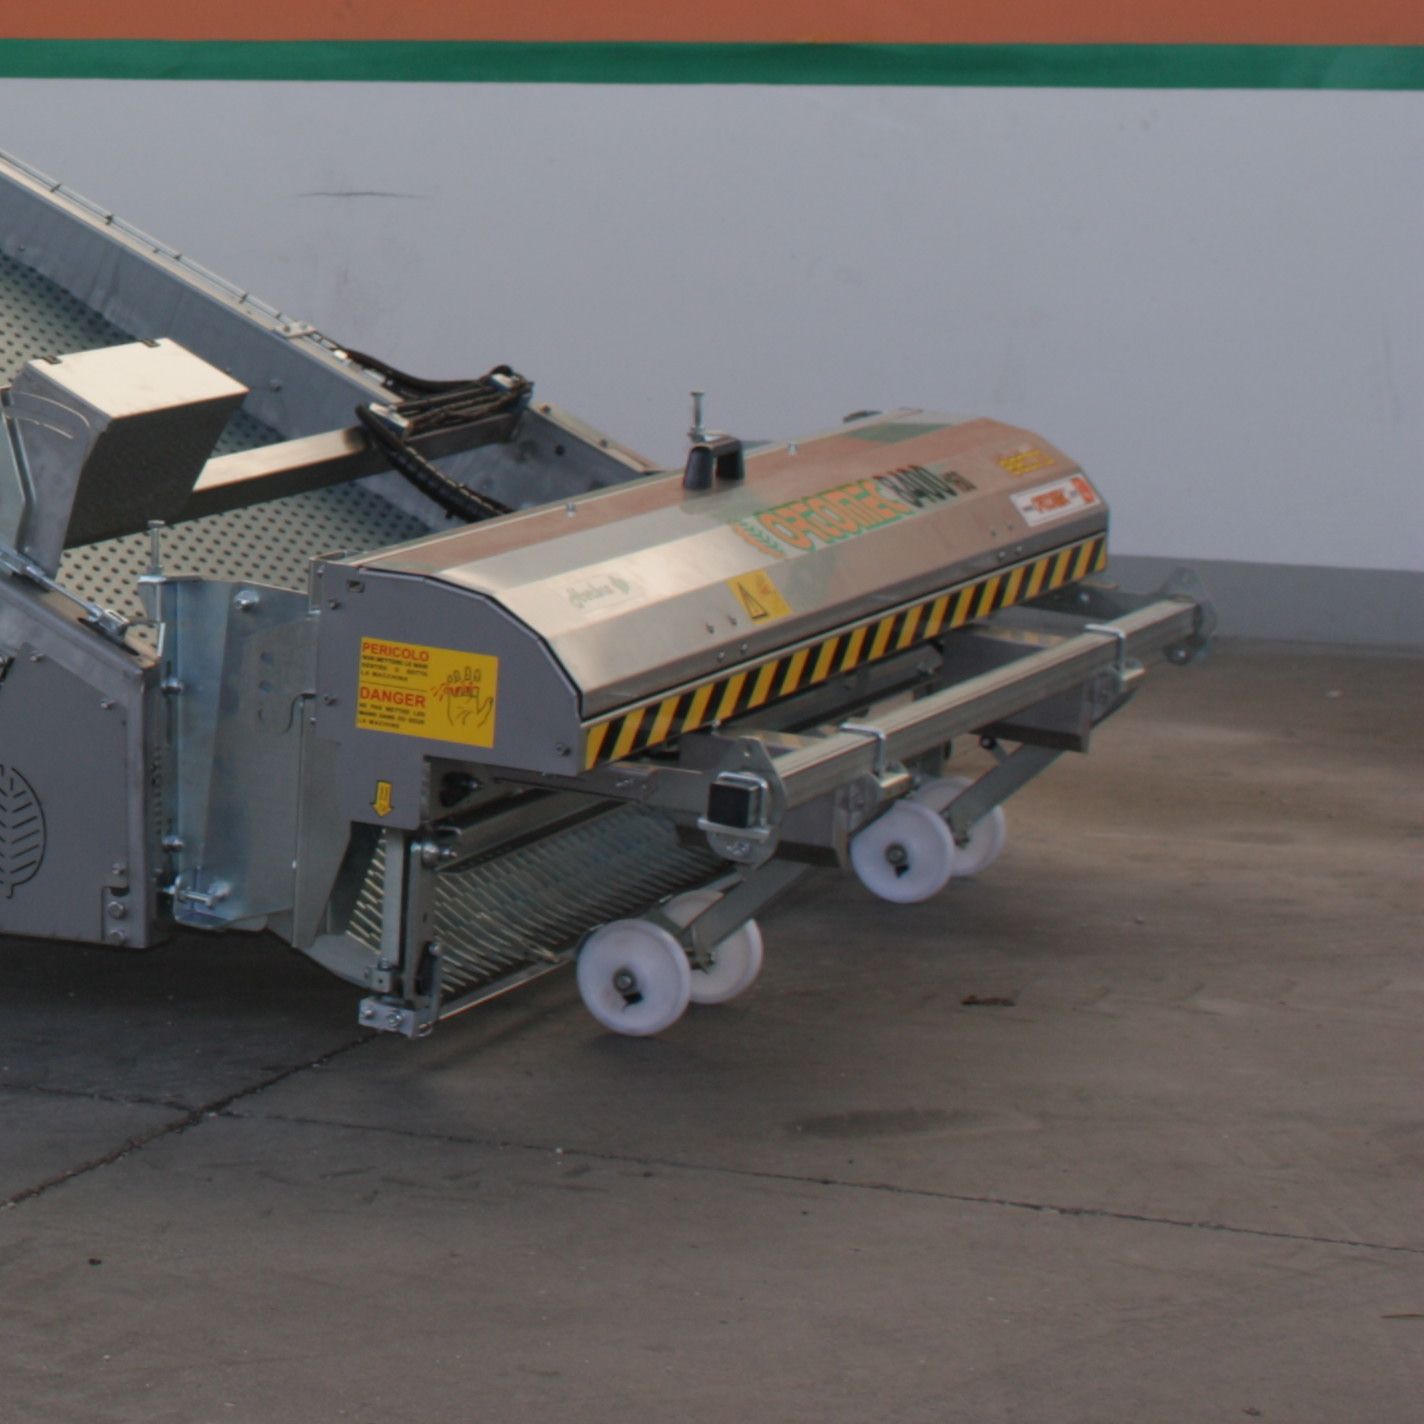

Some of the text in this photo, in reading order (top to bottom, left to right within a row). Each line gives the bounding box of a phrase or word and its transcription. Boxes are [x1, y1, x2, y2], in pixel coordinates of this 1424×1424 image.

[753, 479, 918, 553] ORTOMEC
[362, 642, 430, 662] PERICOLO
[359, 686, 426, 708] DANGER
